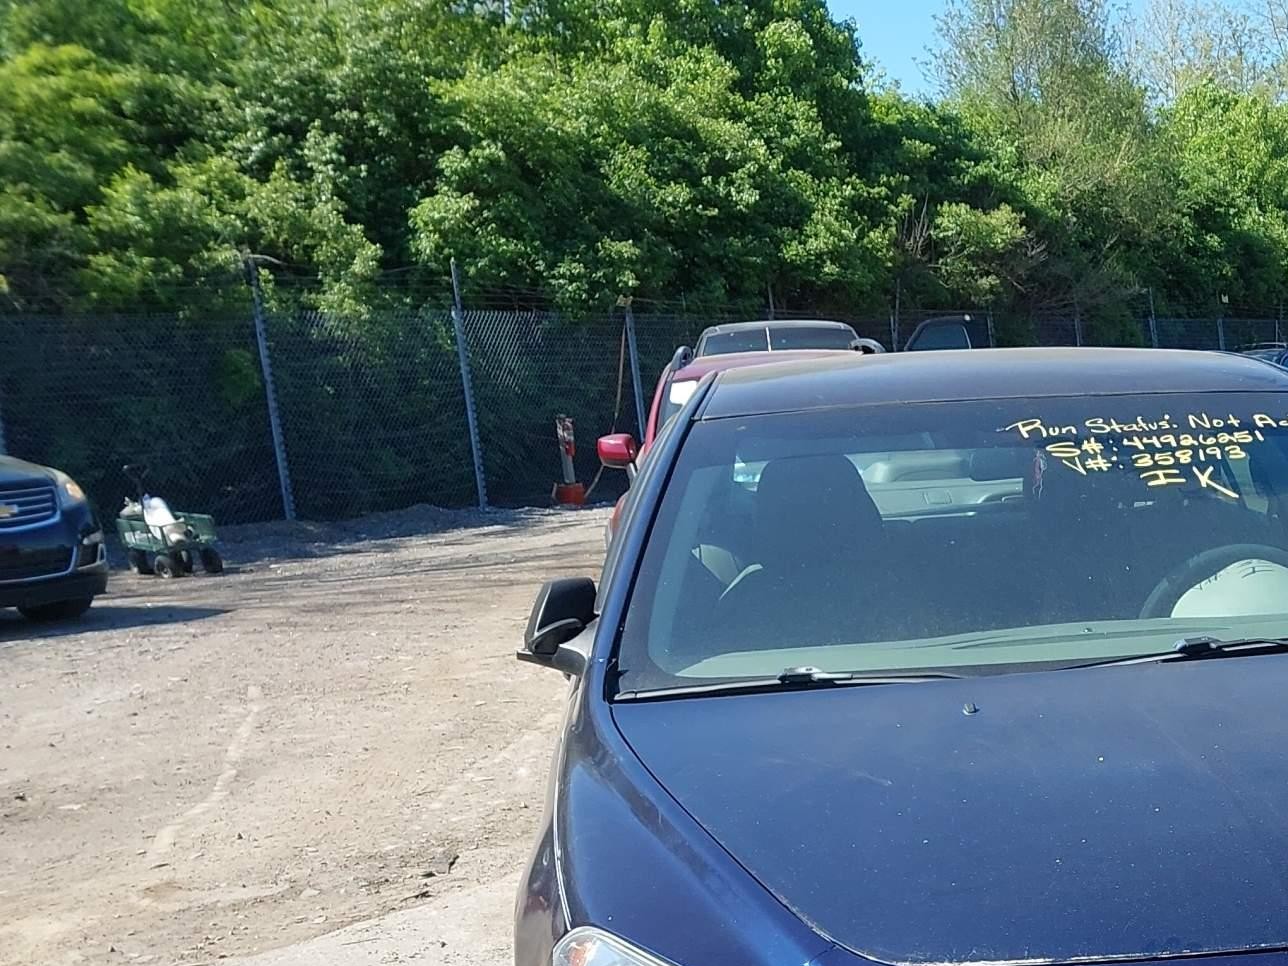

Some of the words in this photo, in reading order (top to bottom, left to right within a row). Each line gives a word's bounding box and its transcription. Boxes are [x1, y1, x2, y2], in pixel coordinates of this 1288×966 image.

[1005, 418, 1078, 439] Run
[1187, 413, 1241, 429] Not
[1123, 430, 1265, 450] 44926251
[1131, 445, 1247, 467] 358193
